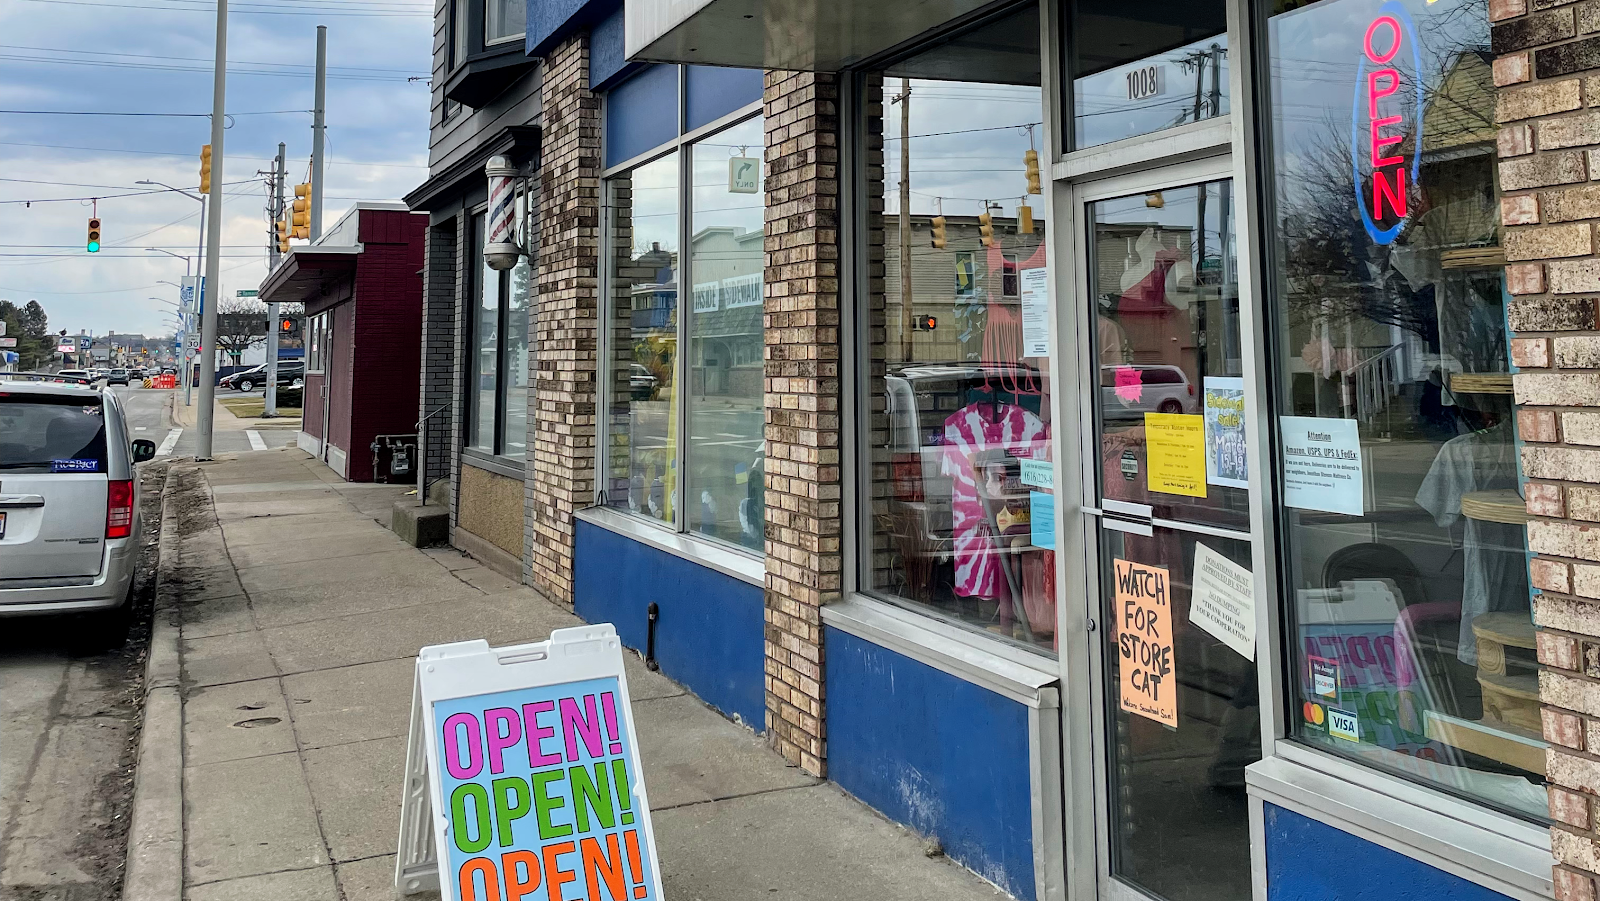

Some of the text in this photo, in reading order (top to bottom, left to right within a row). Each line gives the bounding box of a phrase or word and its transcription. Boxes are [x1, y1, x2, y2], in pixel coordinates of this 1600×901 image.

[1127, 66, 1156, 100] 1008
[1363, 15, 1407, 222] OPEN
[695, 275, 761, 310] INSIDE SIDEWALK
[1206, 392, 1244, 411] Sidewal
[1308, 431, 1332, 441] Attention
[1323, 448, 1335, 457] UPS
[1335, 449, 1340, 458] &
[1117, 563, 1165, 606] WATCH
[1201, 563, 1228, 584] APPROVED
[1227, 578, 1235, 588] BY
[1235, 582, 1252, 598] STAFF
[1205, 555, 1249, 587] DONATIONS MUST
[1125, 600, 1159, 638] FOR
[1196, 604, 1211, 620] YOUR
[1208, 591, 1217, 602] NO
[1215, 594, 1240, 616] DUMPING
[1221, 609, 1234, 624] YOU
[1234, 618, 1246, 632] FOR
[1120, 632, 1171, 678] STORE
[1314, 663, 1335, 675] We Accept
[1131, 668, 1161, 701] CAT
[1315, 680, 1334, 689] DISCOVER
[442, 691, 623, 780] OPEN!
[1332, 716, 1355, 733] VISA
[450, 758, 635, 854] OPEN!
[458, 828, 648, 901] OPEN!
